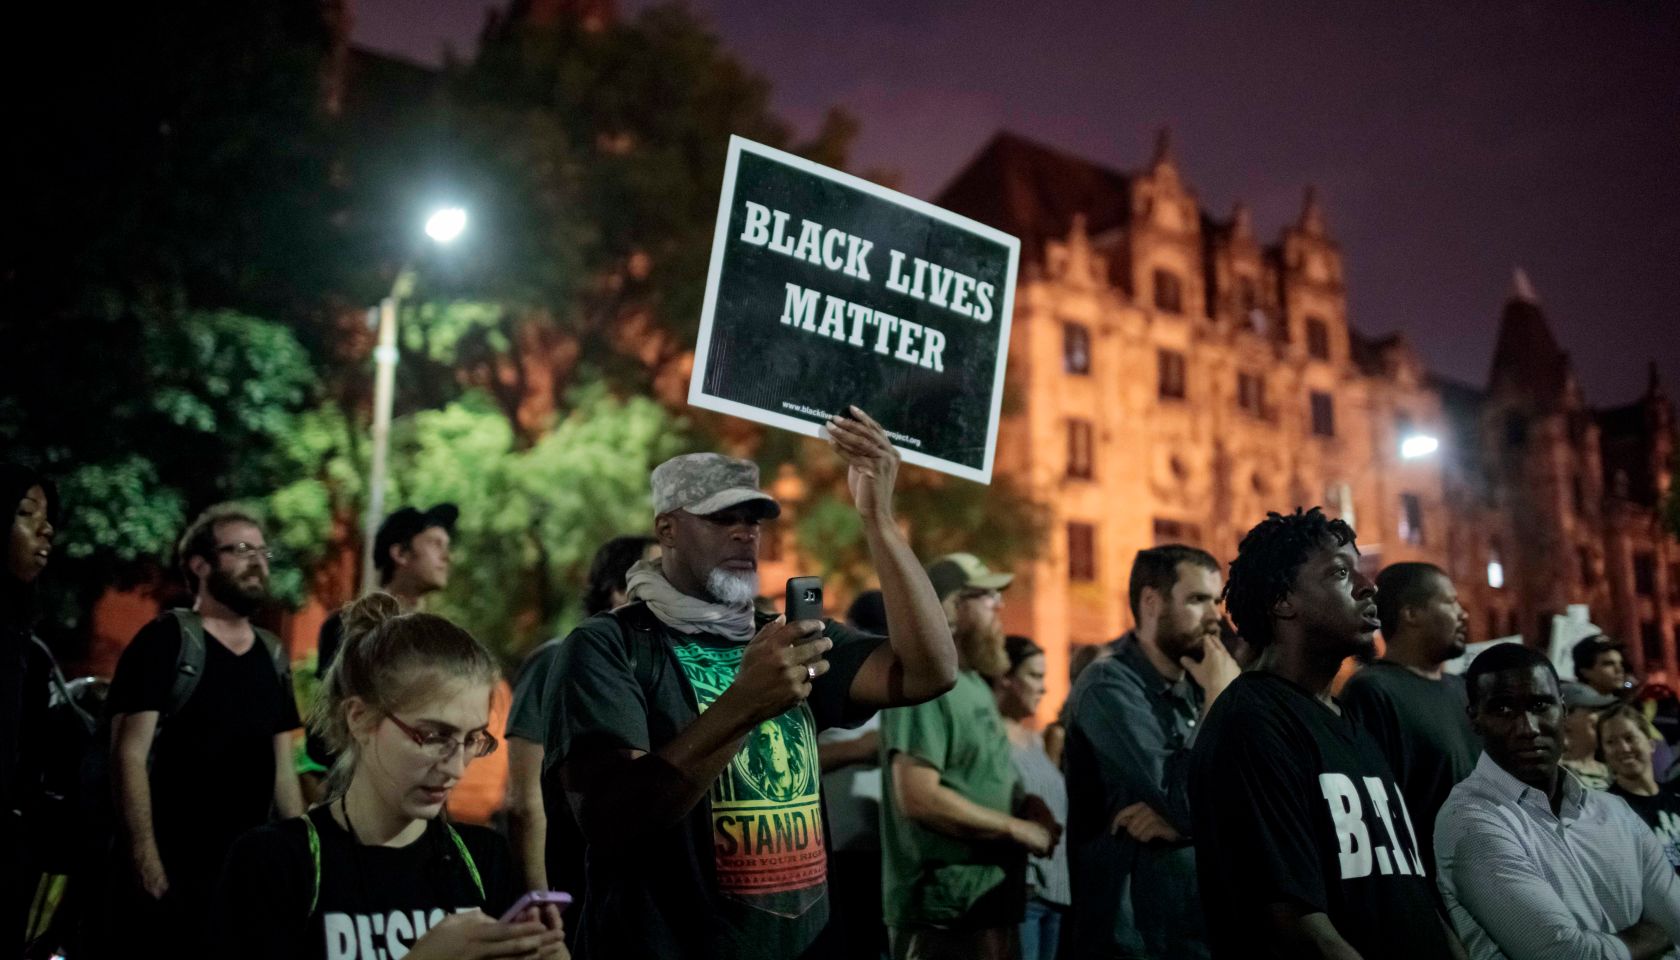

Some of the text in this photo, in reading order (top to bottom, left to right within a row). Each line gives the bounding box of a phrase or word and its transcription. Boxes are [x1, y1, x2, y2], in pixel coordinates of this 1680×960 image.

[740, 200, 995, 323] BLACK LIVES
[780, 282, 947, 372] MATTER
[715, 811, 809, 856] STAND
[759, 855, 797, 866] YOUR
